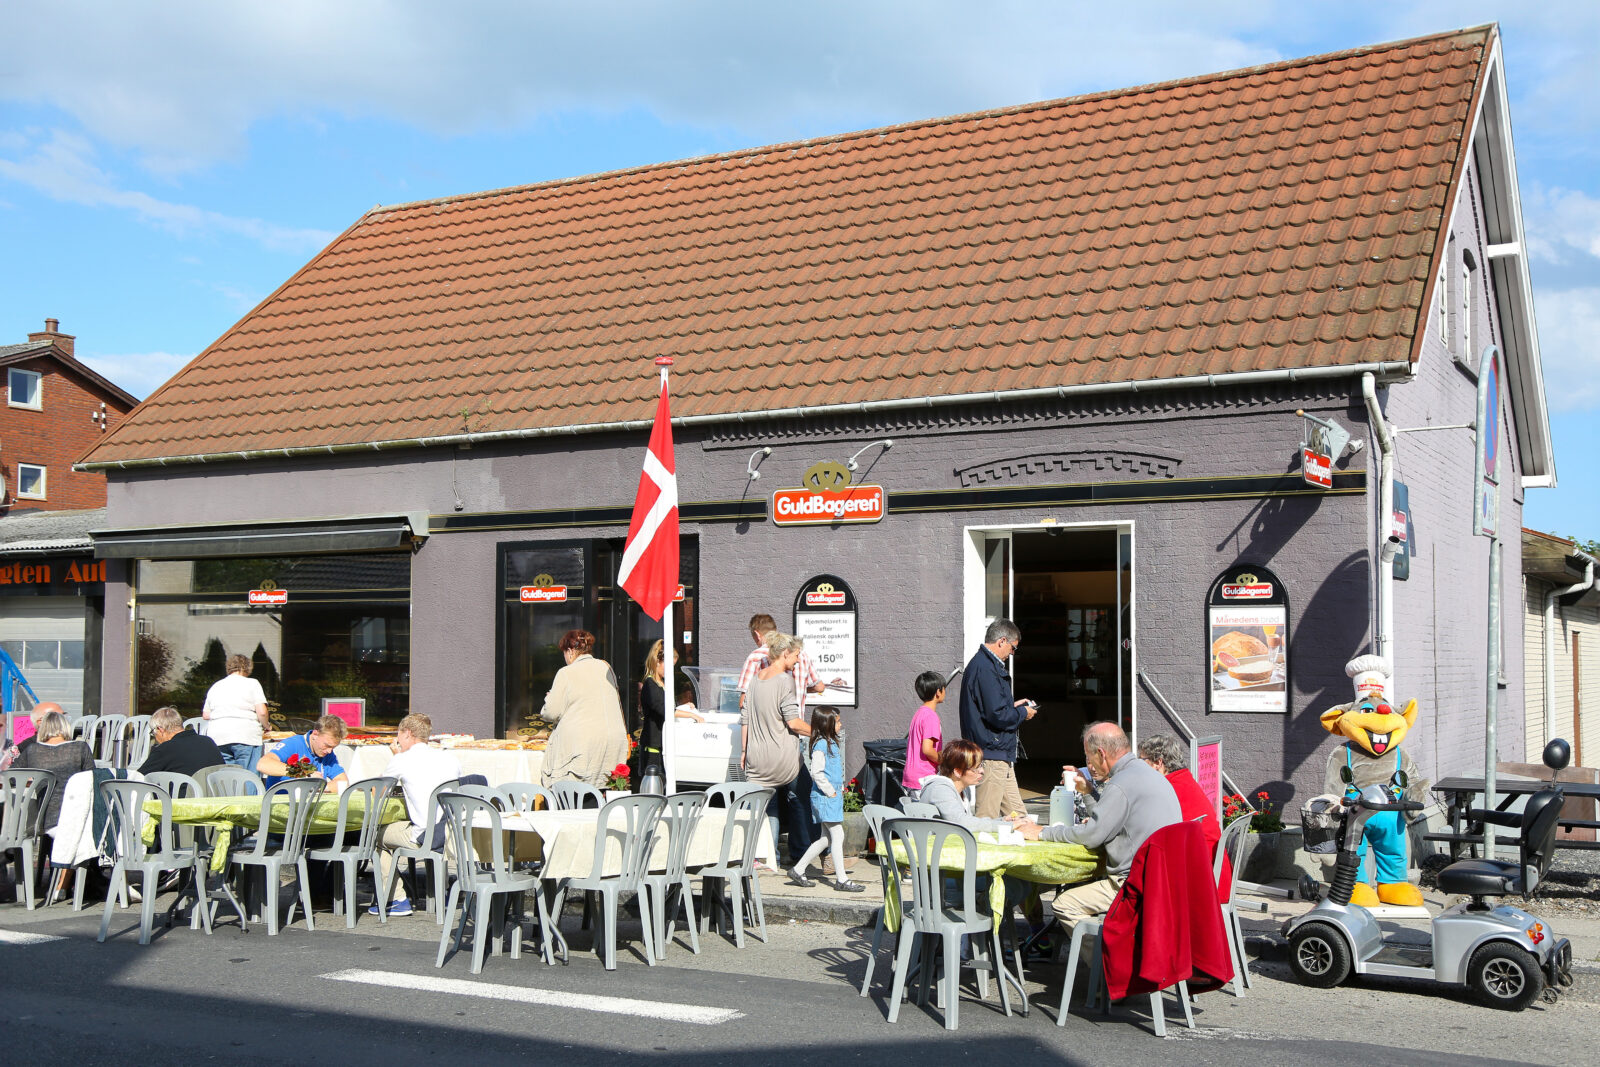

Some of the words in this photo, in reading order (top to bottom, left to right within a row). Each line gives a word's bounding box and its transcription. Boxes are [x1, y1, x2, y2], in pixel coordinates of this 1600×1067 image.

[777, 495, 879, 517] GuldBageren
[522, 589, 565, 600] GuldBageren
[1224, 586, 1271, 597] GuldBageren
[1216, 614, 1259, 624] Månedens
